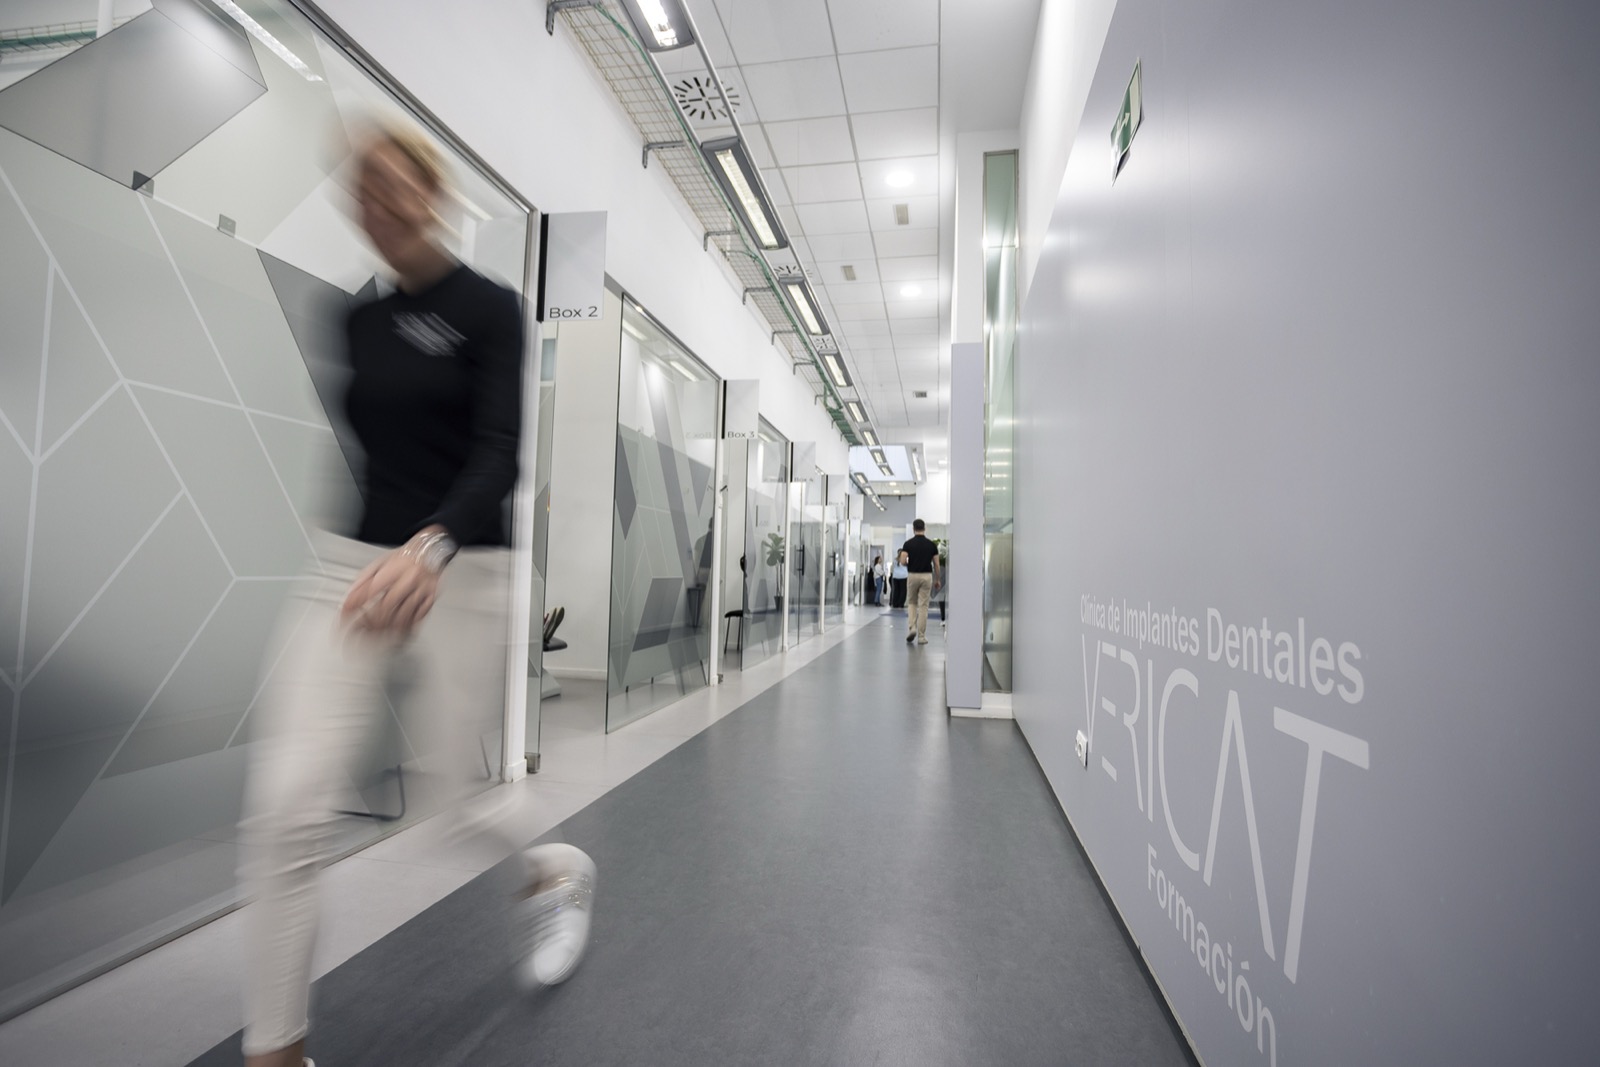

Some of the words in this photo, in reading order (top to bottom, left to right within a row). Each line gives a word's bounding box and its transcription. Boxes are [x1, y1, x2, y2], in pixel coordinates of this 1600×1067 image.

[549, 307, 582, 318] Box
[588, 305, 598, 317] 2
[727, 431, 746, 439] Box
[748, 430, 755, 438] 3
[1107, 597, 1120, 634] de
[1123, 598, 1200, 657] Implantes
[1206, 607, 1365, 704] Dentales
[1082, 633, 1370, 985] VERICAT
[1147, 842, 1277, 1067] Formación
